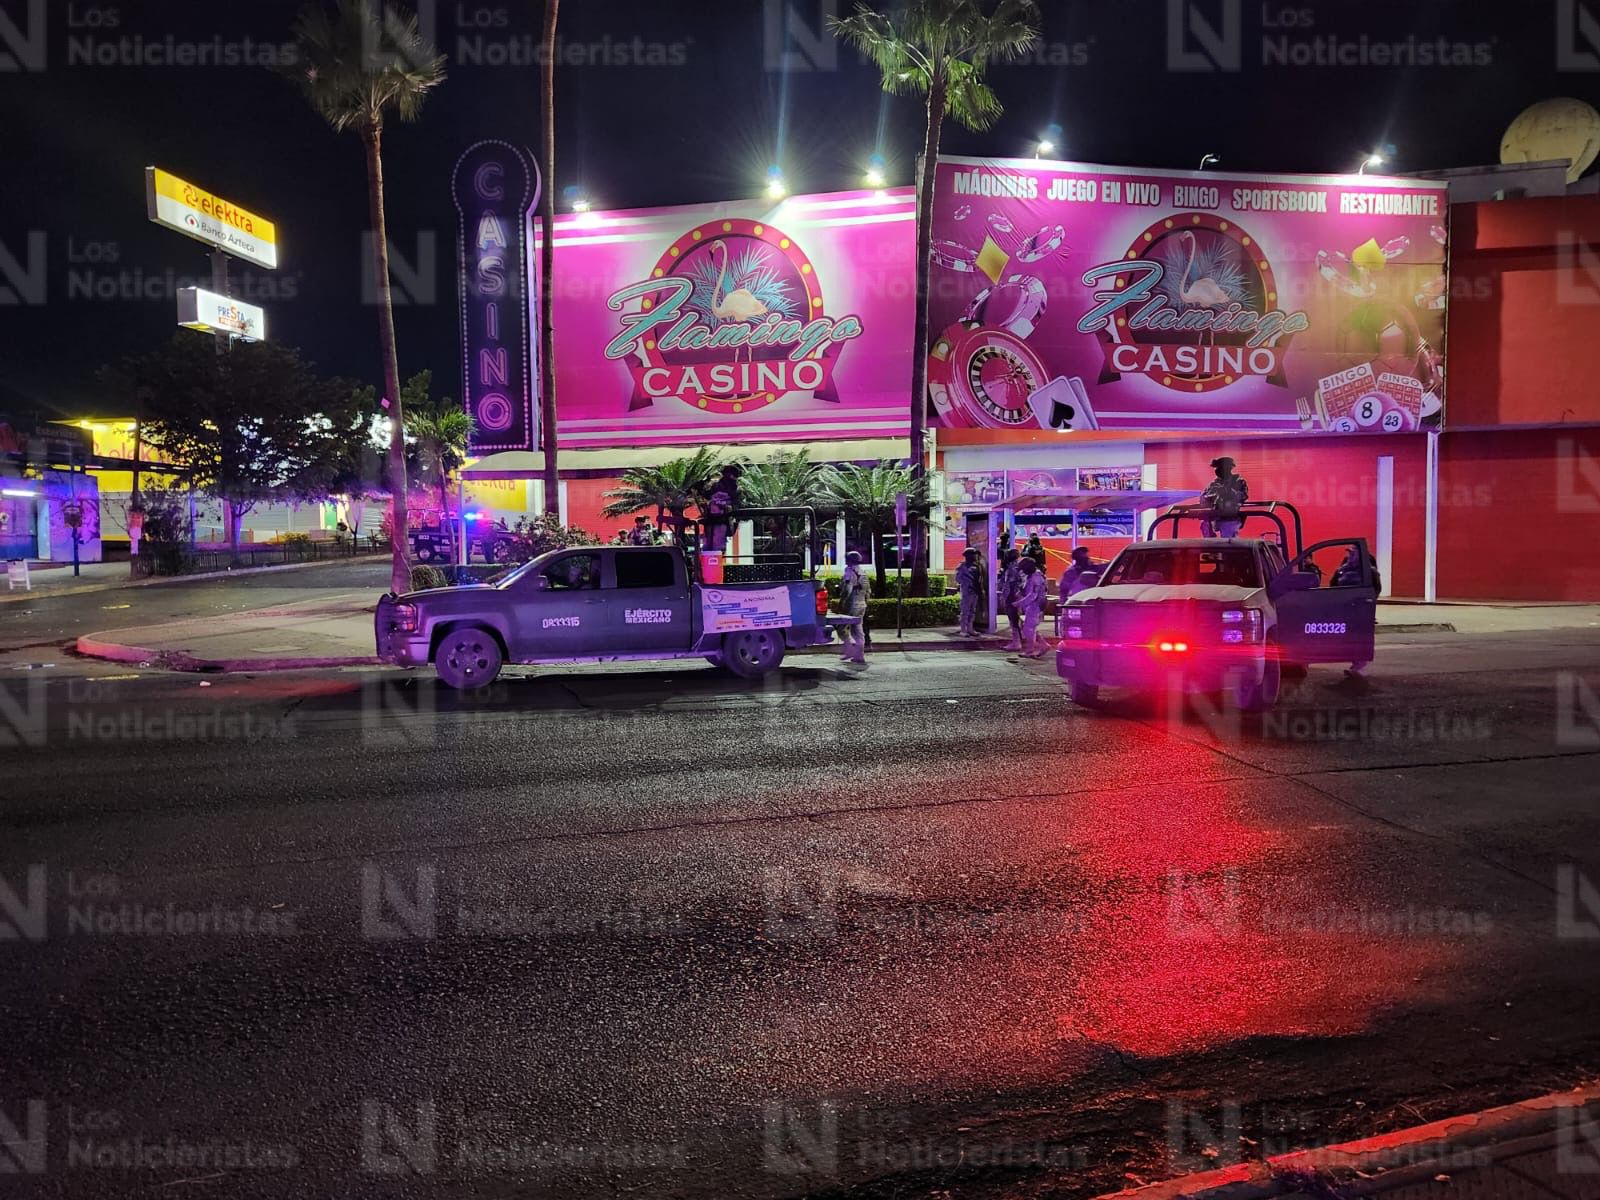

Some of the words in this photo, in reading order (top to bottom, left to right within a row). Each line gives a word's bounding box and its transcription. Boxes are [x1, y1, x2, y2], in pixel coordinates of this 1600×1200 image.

[954, 168, 1038, 199] MÁQUINAS
[1047, 178, 1098, 202] JUEGO
[1102, 180, 1121, 204] EN
[1125, 182, 1161, 206] VIVO
[1173, 184, 1219, 208] BINGO
[1231, 188, 1327, 213] SPORTSBOOK
[1340, 192, 1438, 216] RESTAURANTE
[201, 198, 254, 233] elektra
[201, 222, 226, 240] Banco
[228, 234, 255, 253] Azteca
[474, 162, 513, 429] CASINO
[1076, 260, 1309, 348] Flamingo
[217, 304, 246, 321] PRESTA
[603, 277, 864, 361] Flamingo
[1111, 345, 1276, 374] CASINO
[642, 359, 824, 396] CASINO
[1322, 366, 1367, 390] BINGO
[1382, 374, 1420, 387] BINGO
[1361, 401, 1373, 419] 8
[1384, 415, 1399, 427] 23
[1341, 421, 1351, 432] 5
[624, 608, 672, 618] EJÉRCITO
